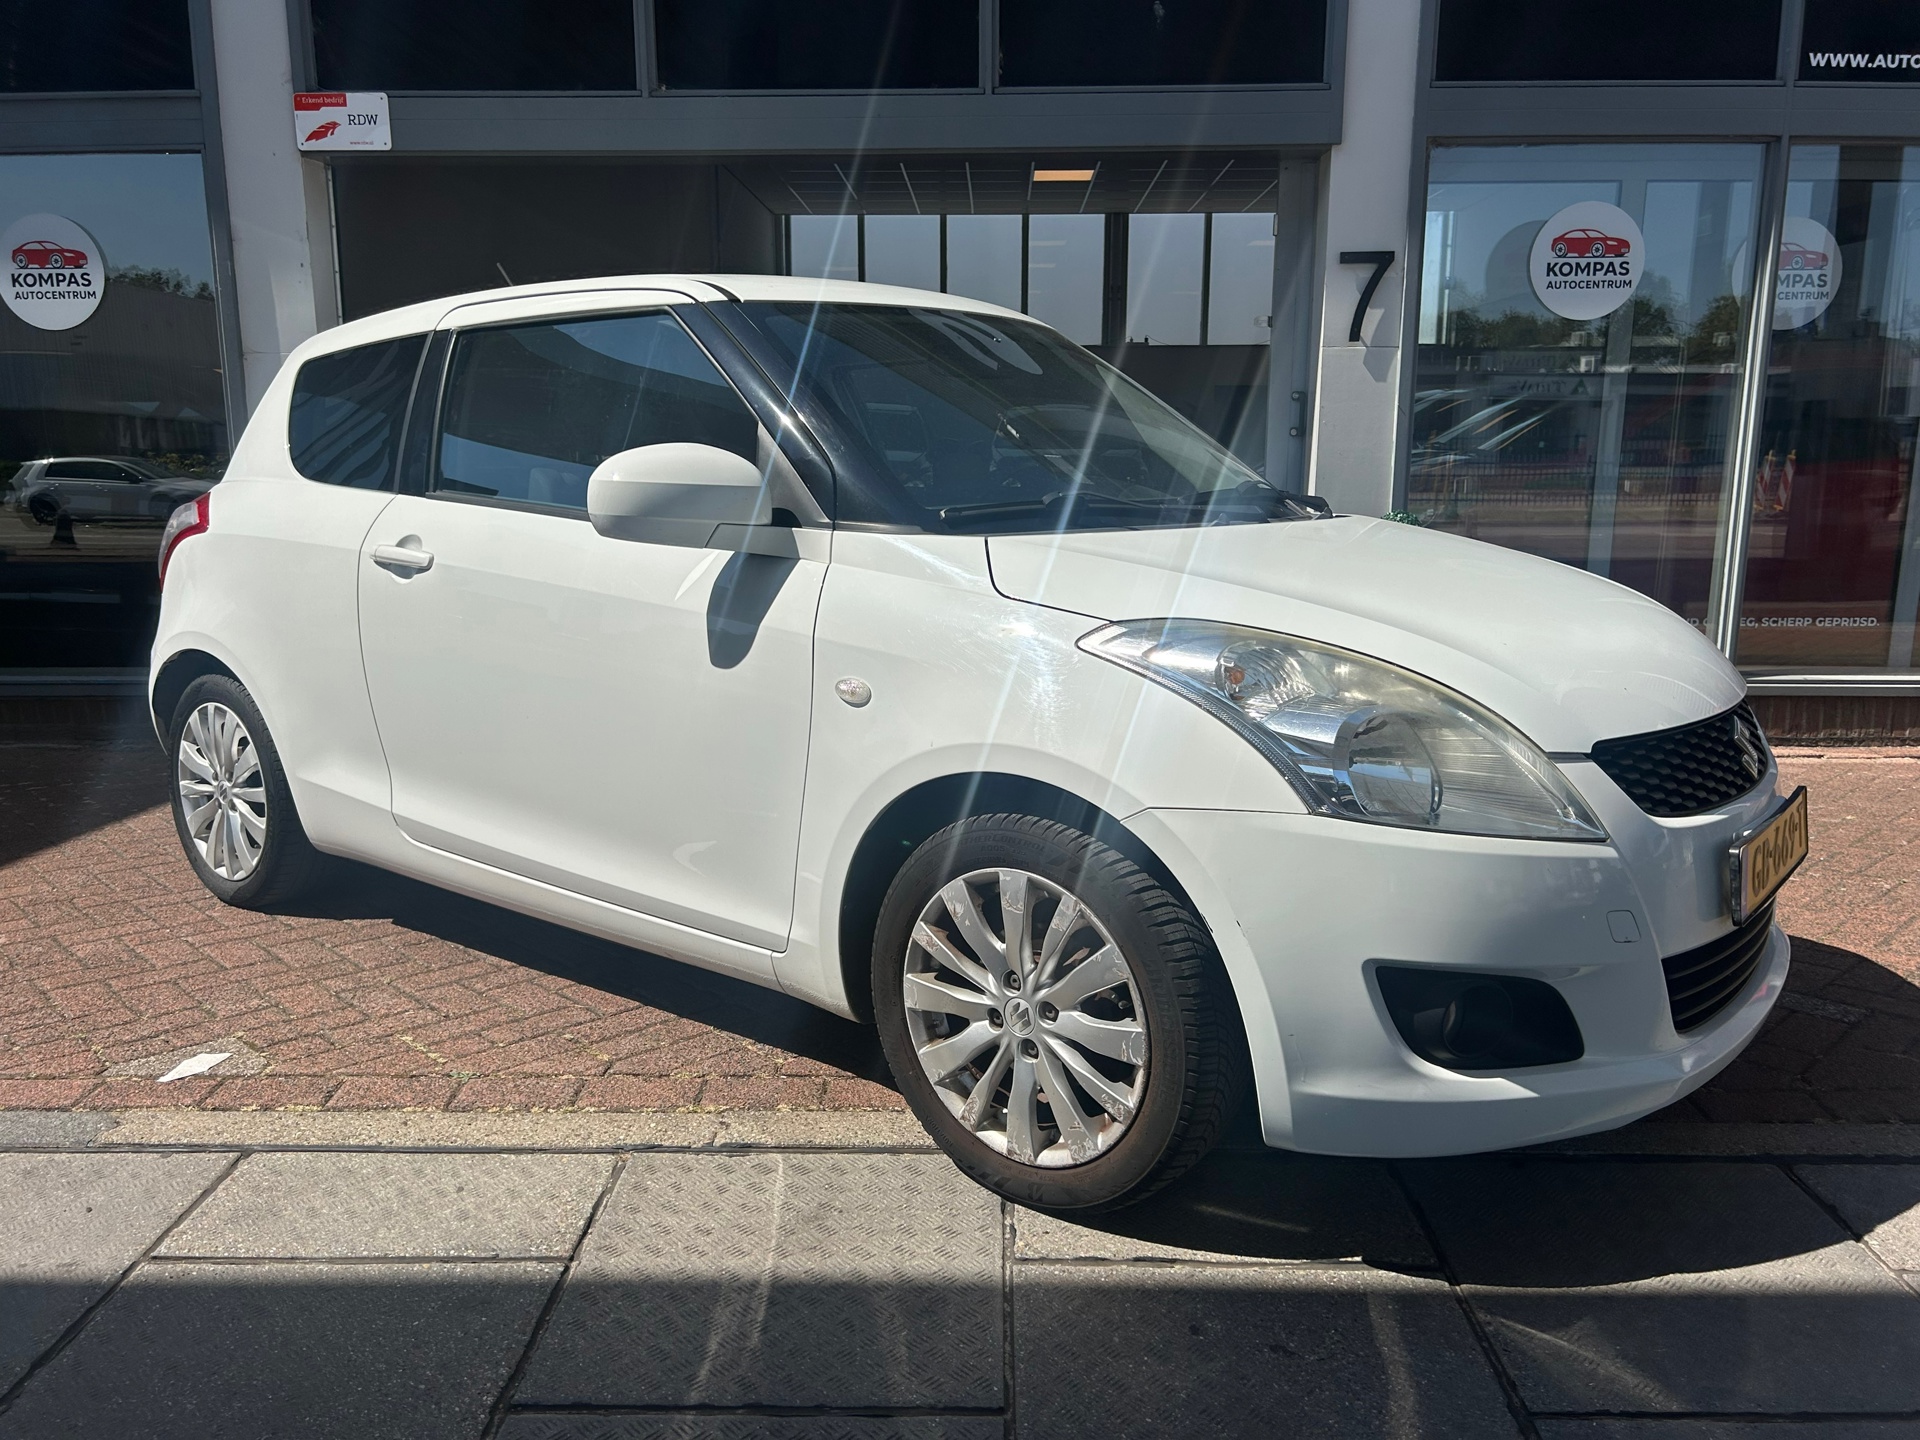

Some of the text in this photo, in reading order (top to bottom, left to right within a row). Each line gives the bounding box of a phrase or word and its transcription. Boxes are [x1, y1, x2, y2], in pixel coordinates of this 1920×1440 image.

[301, 96, 344, 105] Erkend bedrijf
[347, 114, 378, 126] RDW
[1546, 261, 1631, 277] KOMPAS
[11, 272, 92, 288] KOMPAS
[1546, 279, 1632, 290] AUTOCENTRUM
[1777, 273, 1828, 288] MPAS
[14, 290, 97, 300] AUTOCENTRUM
[1339, 250, 1396, 343] 7
[1777, 291, 1829, 300] CENTRUM
[1761, 617, 1813, 627] SCHERP
[1815, 617, 1880, 627] GEPRIJSD.
